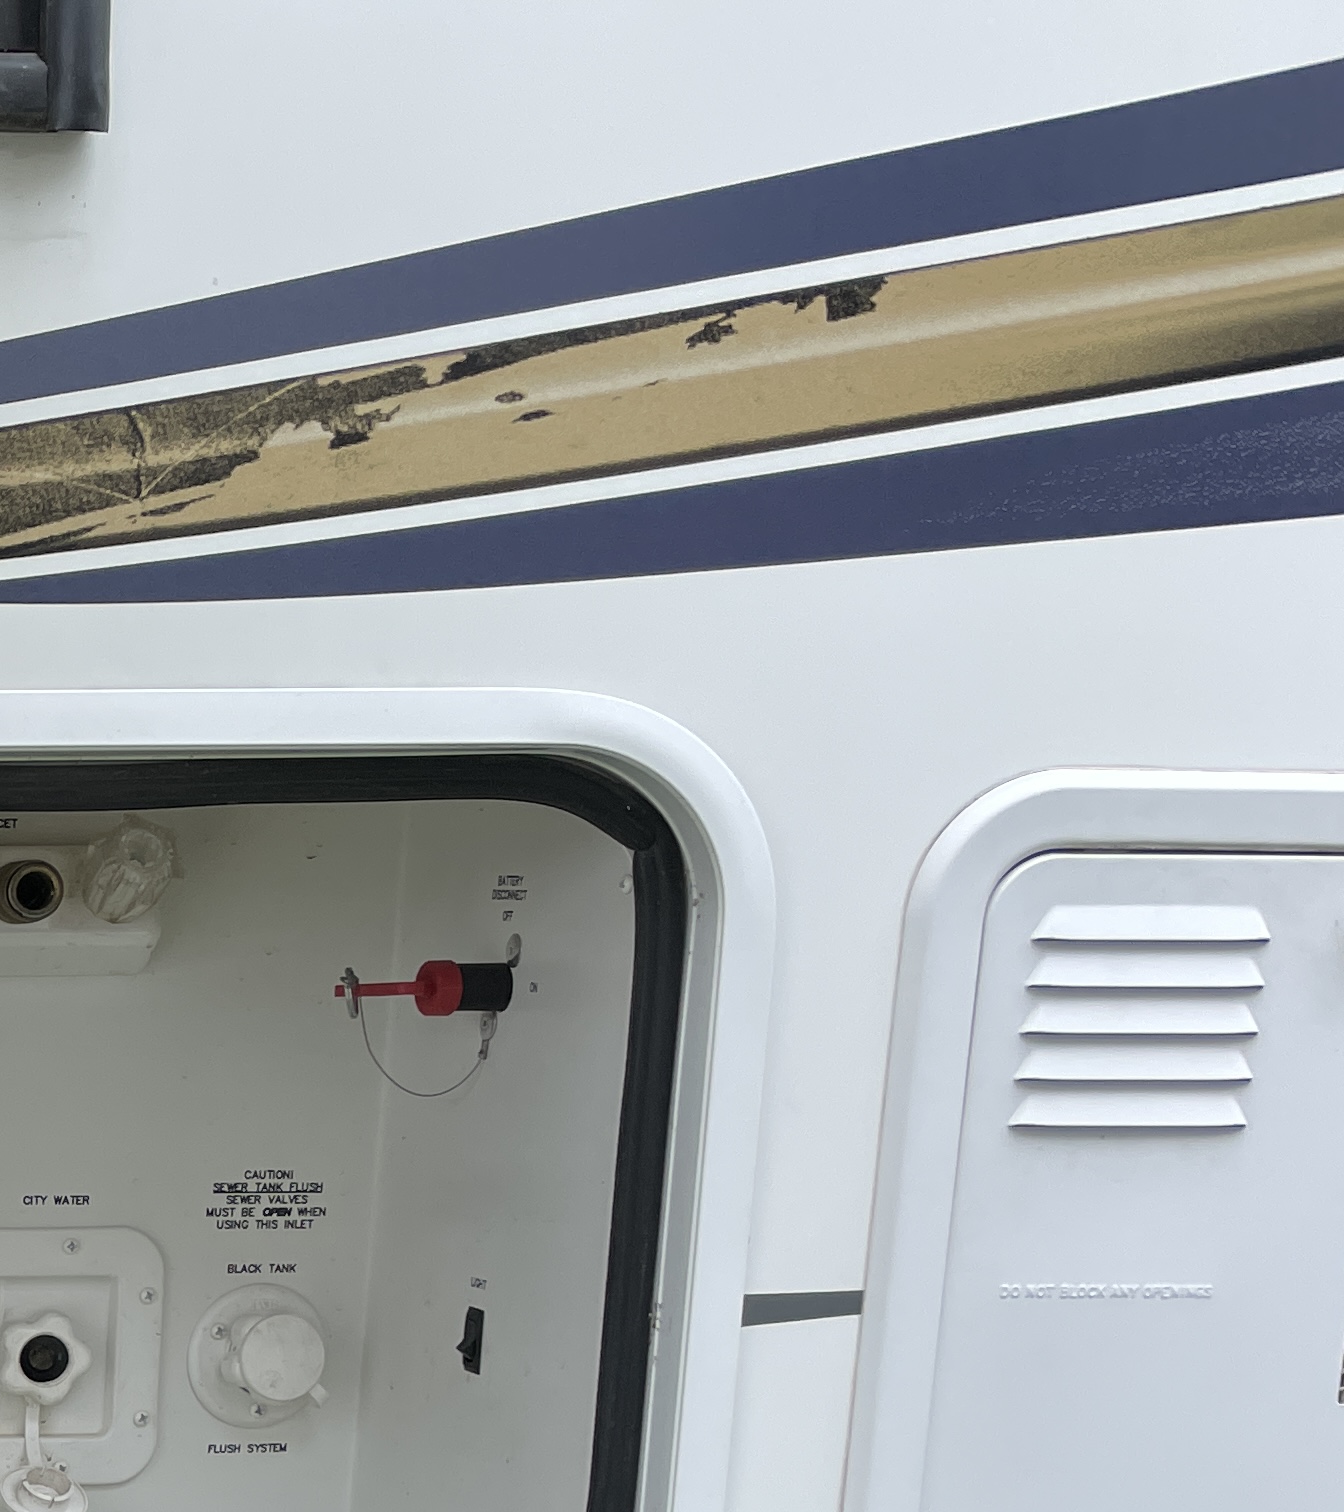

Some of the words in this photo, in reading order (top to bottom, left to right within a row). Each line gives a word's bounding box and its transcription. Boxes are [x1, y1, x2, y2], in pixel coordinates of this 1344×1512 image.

[213, 1182, 248, 1193] SEWER
[255, 1182, 284, 1193] TANK
[289, 1182, 323, 1193] FLUSH
[22, 1195, 48, 1206] CITY
[53, 1195, 90, 1206] WATER
[226, 1195, 261, 1205] SEWER
[268, 1194, 309, 1204] VALVES
[205, 1207, 236, 1217] MUST
[241, 1207, 256, 1217] BE
[262, 1207, 293, 1217] OPEN
[297, 1206, 327, 1217] WHEN
[216, 1220, 249, 1230] USING
[255, 1219, 278, 1229] THIS
[284, 1219, 314, 1229] INLET
[227, 1264, 262, 1274] BLACK
[269, 1263, 297, 1273] TANK
[207, 1444, 241, 1454] FLUSH
[247, 1443, 288, 1453] SYSTEM
